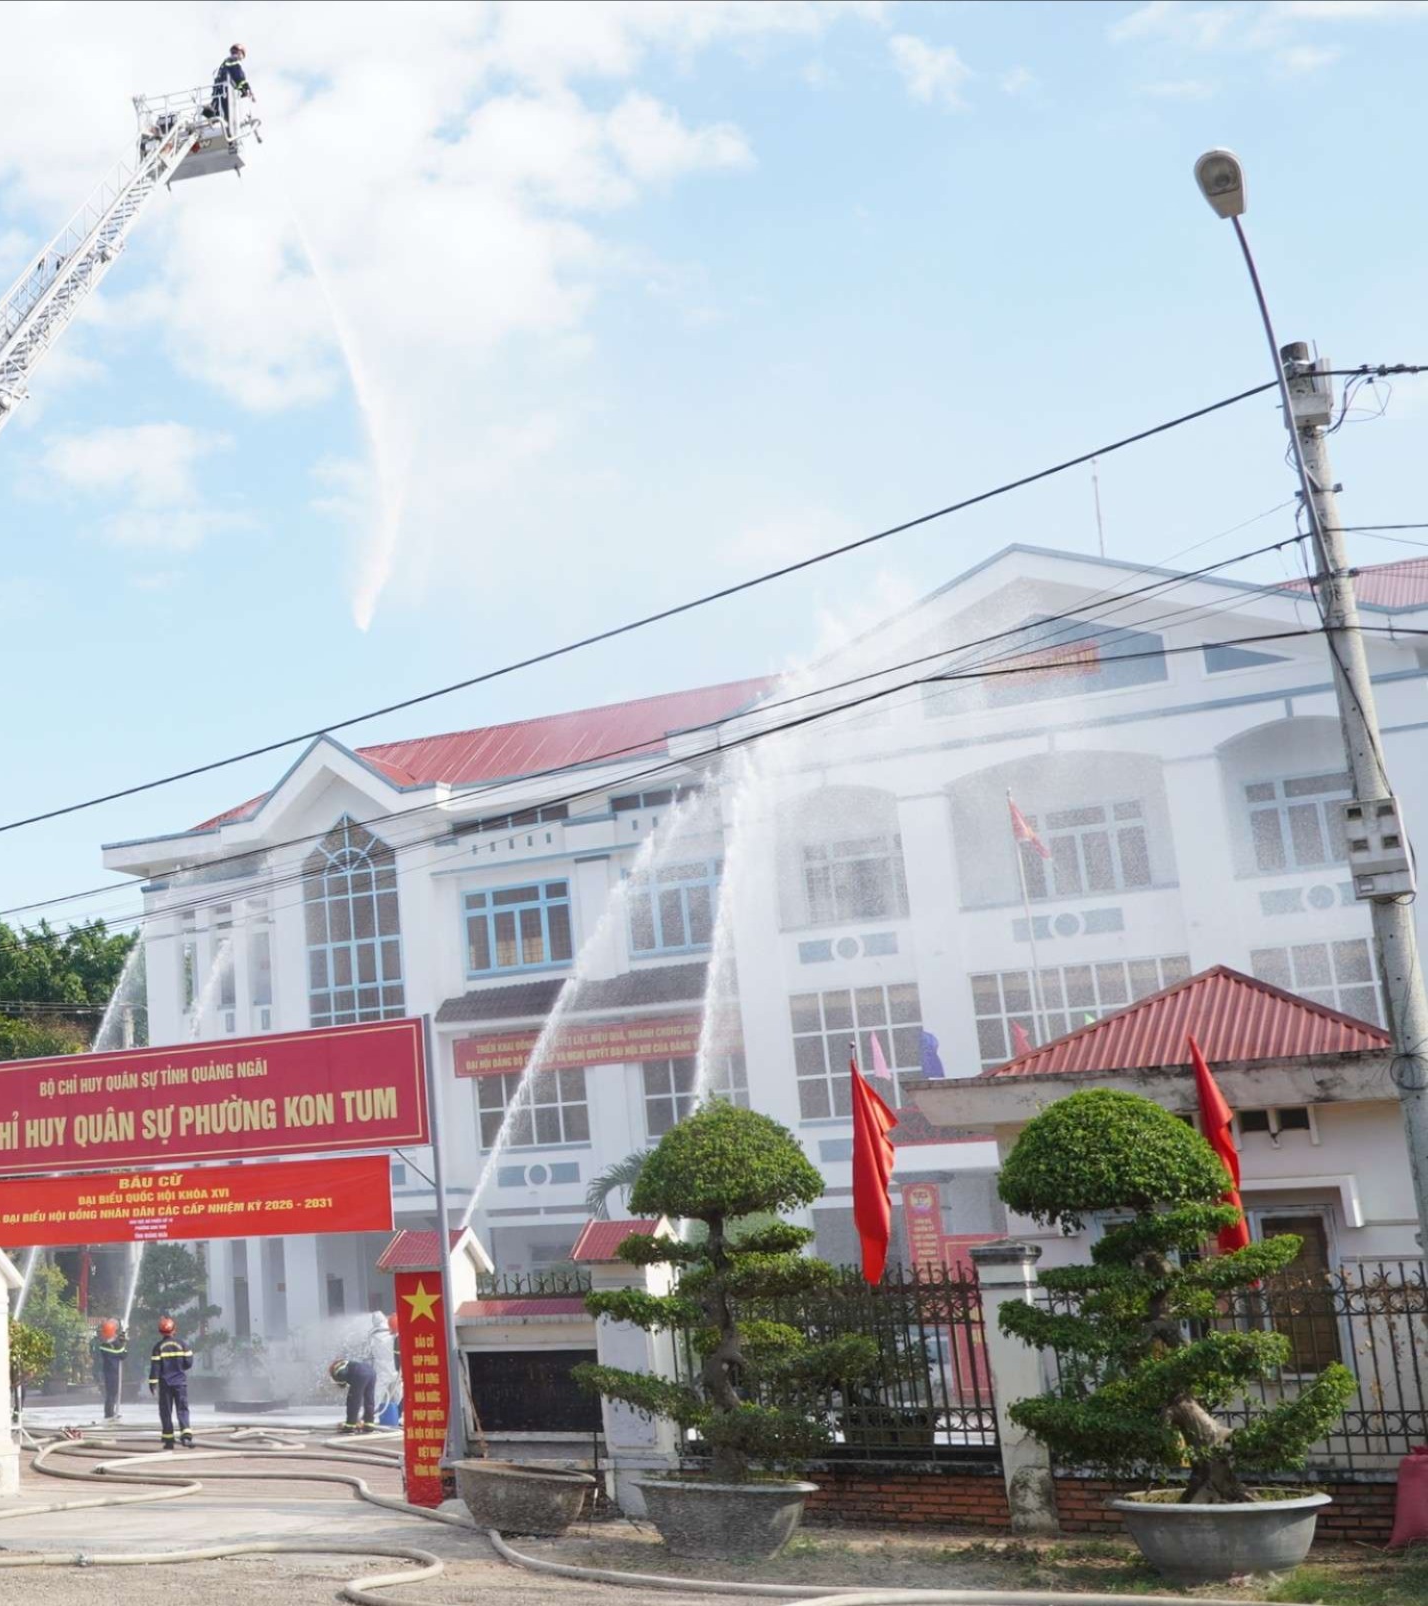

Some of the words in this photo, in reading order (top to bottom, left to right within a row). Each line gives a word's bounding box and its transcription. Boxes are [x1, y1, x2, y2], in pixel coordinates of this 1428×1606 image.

[39, 1078, 55, 1099] BỘ
[58, 1074, 77, 1095] CHỈ
[80, 1077, 102, 1094] HUY
[105, 1071, 138, 1093] QUÂN
[142, 1070, 159, 1091] SỰ
[161, 1064, 188, 1086] TỈNH
[191, 1060, 234, 1085] QUẢNG
[237, 1057, 268, 1078] NGÃI
[25, 1117, 67, 1148] HUY
[74, 1107, 135, 1148] QUÂN
[142, 1103, 174, 1145] SỰ
[179, 1094, 277, 1137] PHƯỜNG
[284, 1093, 335, 1128] KON
[341, 1086, 398, 1123] TUM
[158, 1172, 184, 1187] CỬ
[178, 1188, 208, 1200] KHÓA
[211, 1187, 230, 1198] XVI
[158, 1204, 180, 1217] CÁC
[264, 1200, 294, 1211] 2026
[304, 1198, 333, 1209] 2031
